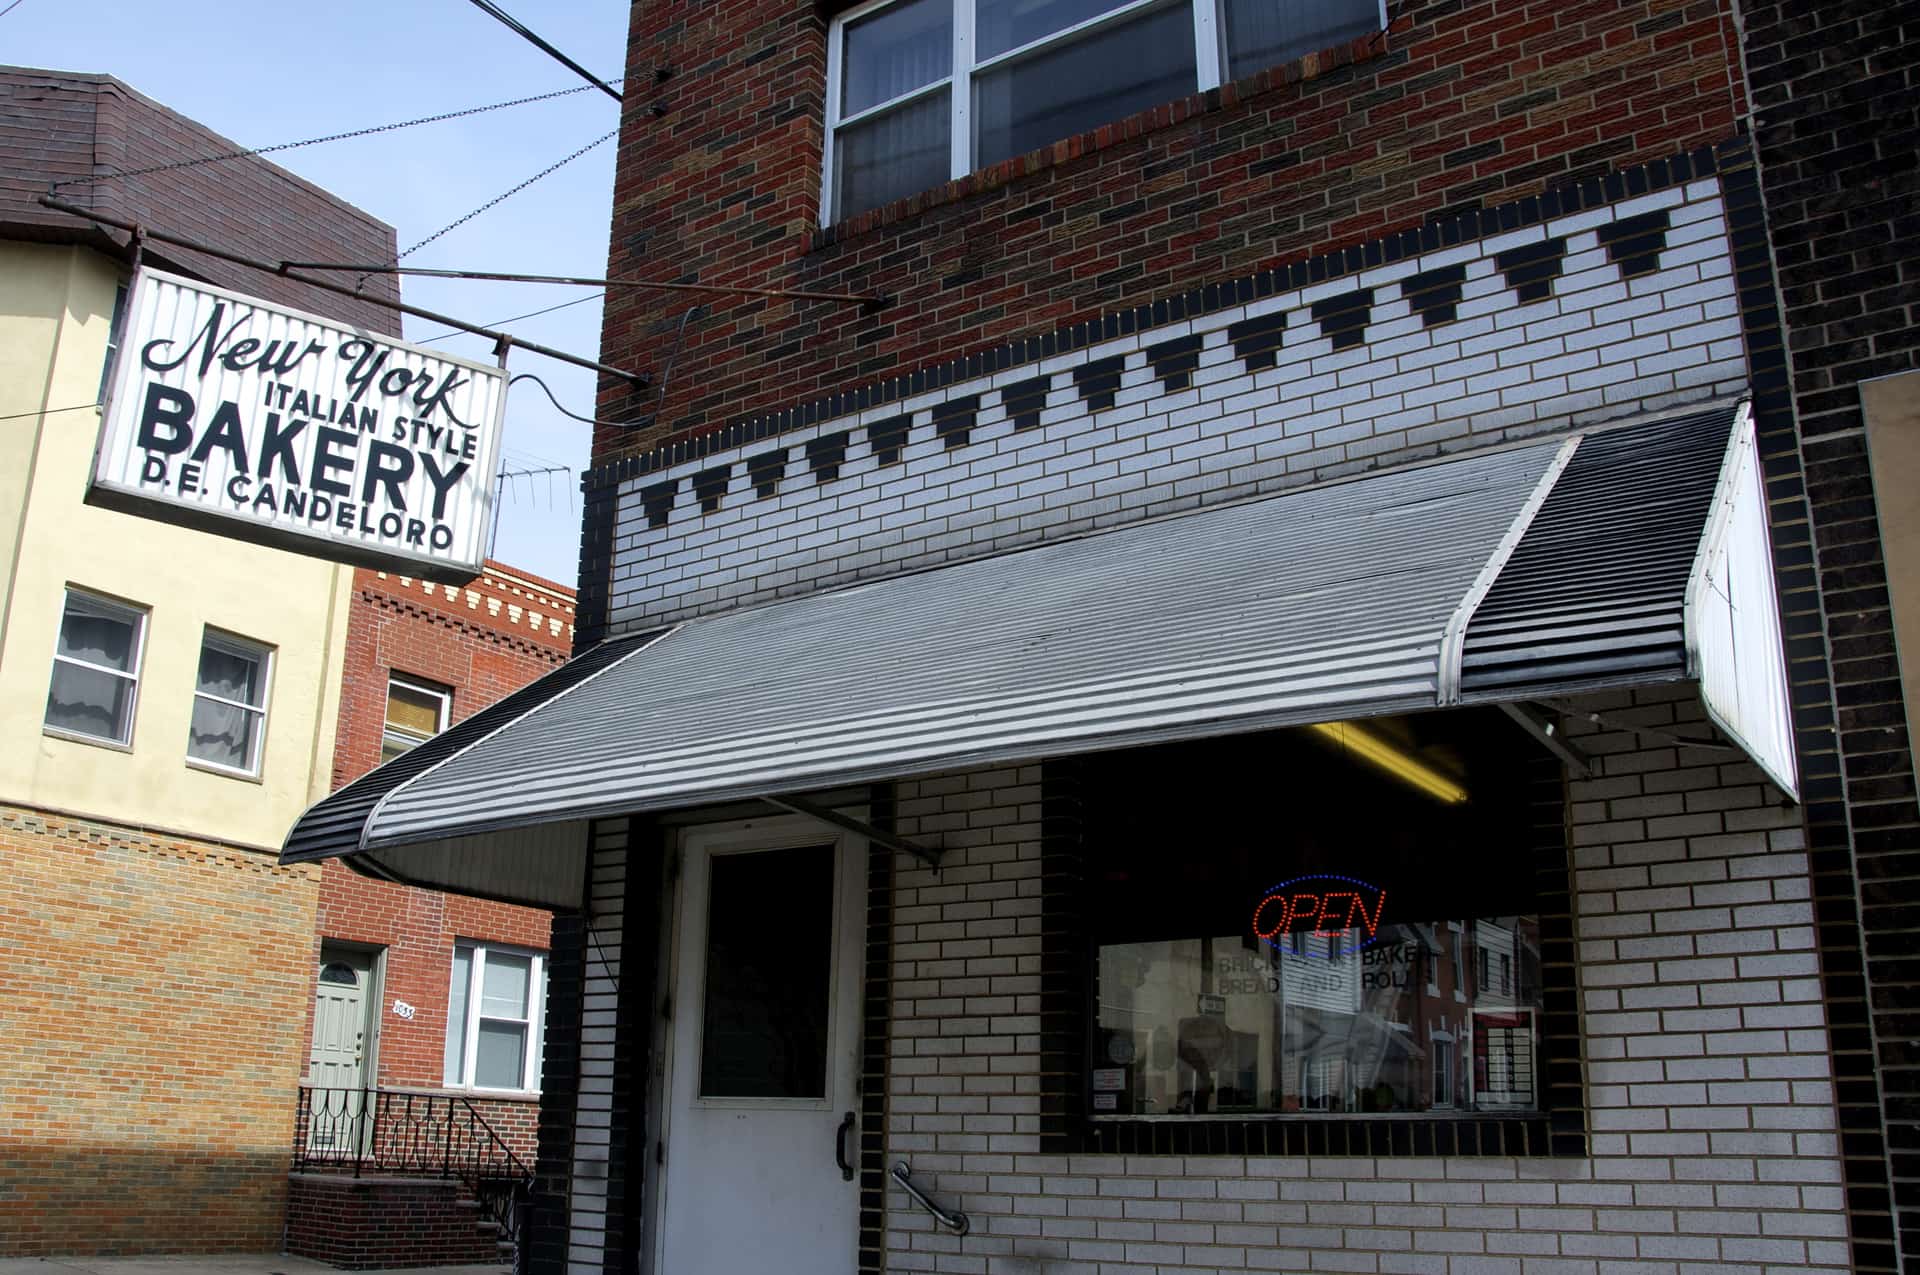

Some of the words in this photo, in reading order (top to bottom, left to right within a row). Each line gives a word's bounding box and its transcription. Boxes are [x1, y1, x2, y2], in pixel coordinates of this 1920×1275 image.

[141, 303, 328, 378] New
[338, 341, 481, 429] York
[137, 381, 471, 520] BAKERY
[264, 381, 379, 434] ITALIAN
[392, 415, 478, 460] STYLE
[142, 455, 209, 496] D.E.
[227, 475, 454, 550] CANDELORO
[1252, 890, 1387, 940] OPEN
[1362, 944, 1424, 965] BAKE
[1219, 977, 1280, 995] BREAD
